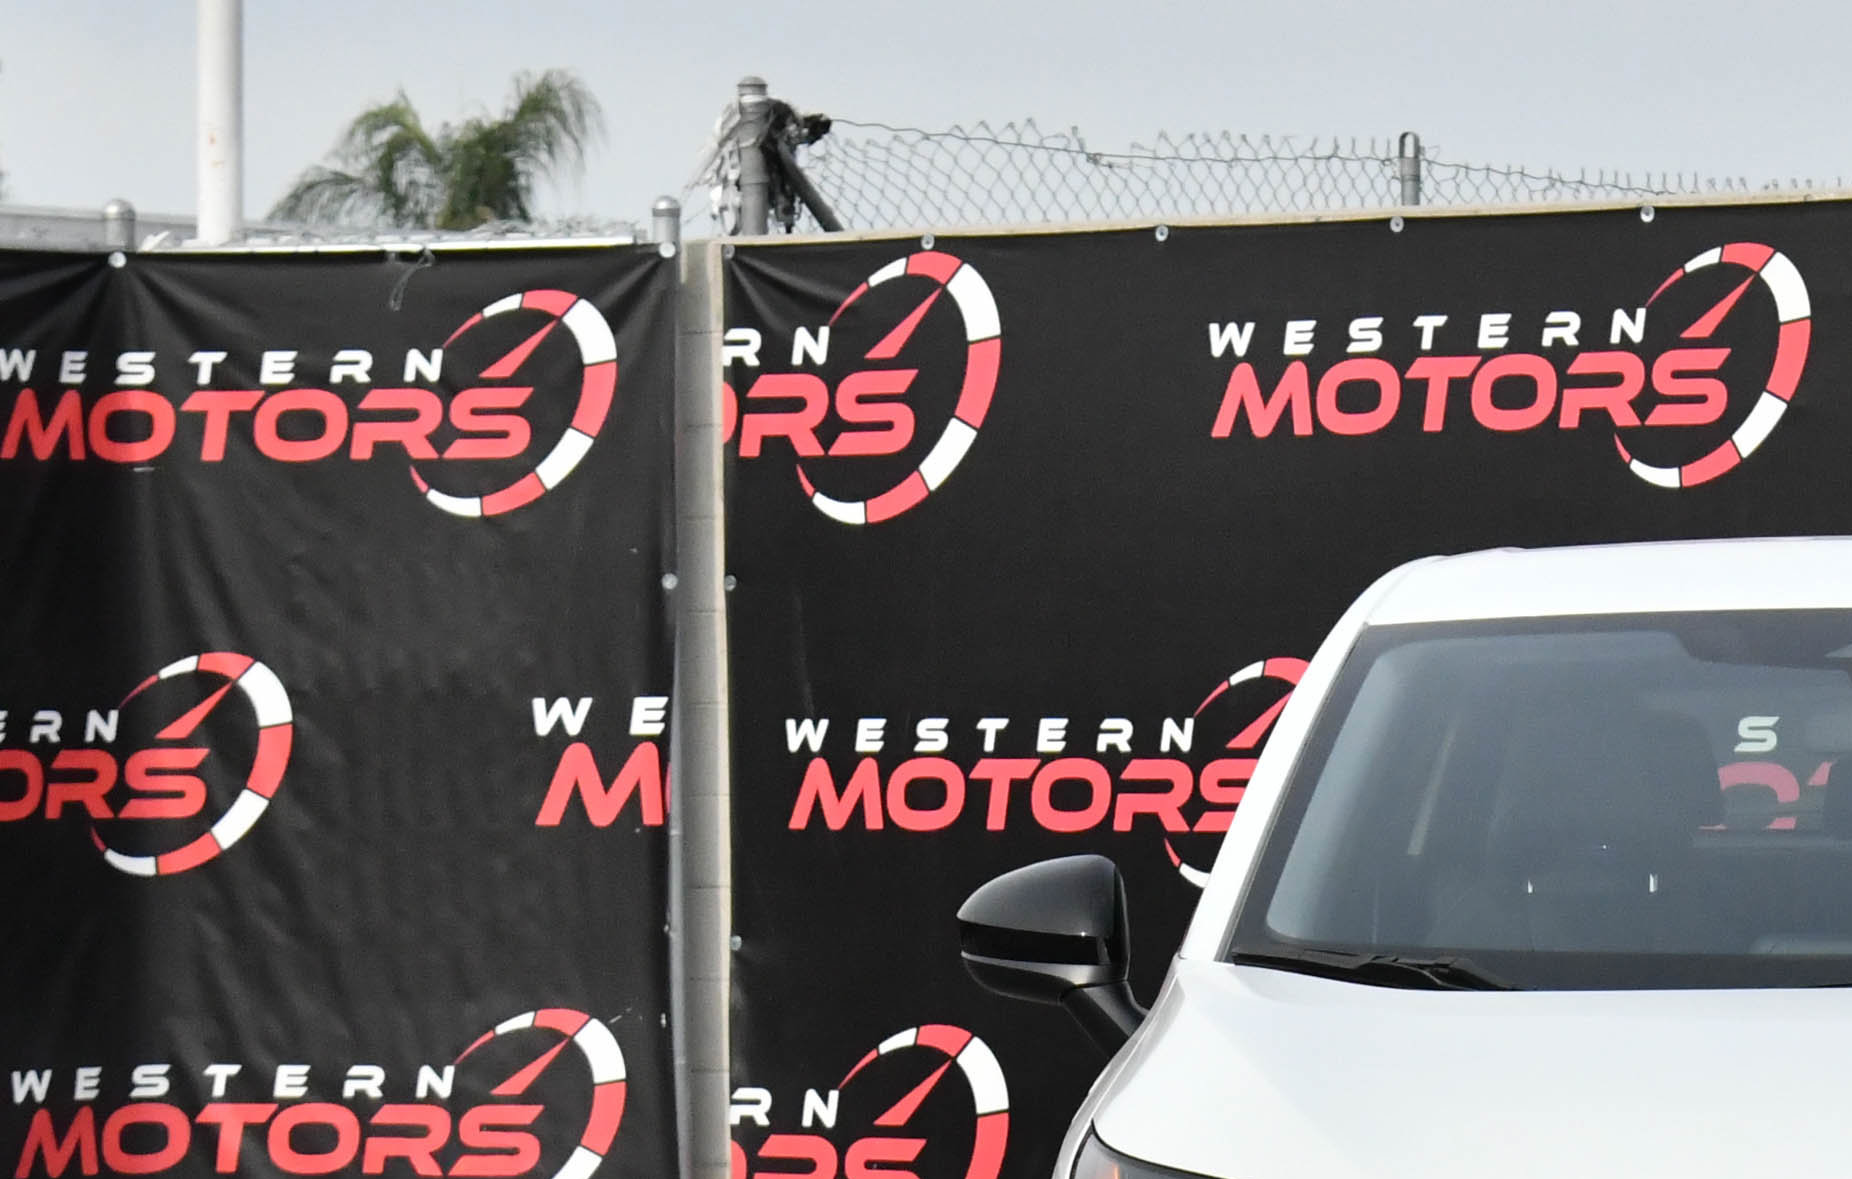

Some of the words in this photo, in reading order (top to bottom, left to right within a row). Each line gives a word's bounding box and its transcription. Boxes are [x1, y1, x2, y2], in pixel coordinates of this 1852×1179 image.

[1209, 308, 1647, 357] WESTERN
[0, 348, 443, 386] WESTERN
[722, 369, 920, 458] RS
[1211, 348, 1731, 438] MOTORS
[0, 386, 534, 463] MOTORS
[0, 709, 119, 743] RN
[785, 717, 1195, 753] WESTERN
[11, 1063, 455, 1103] WESTERN
[15, 1102, 544, 1179] MOTORS
